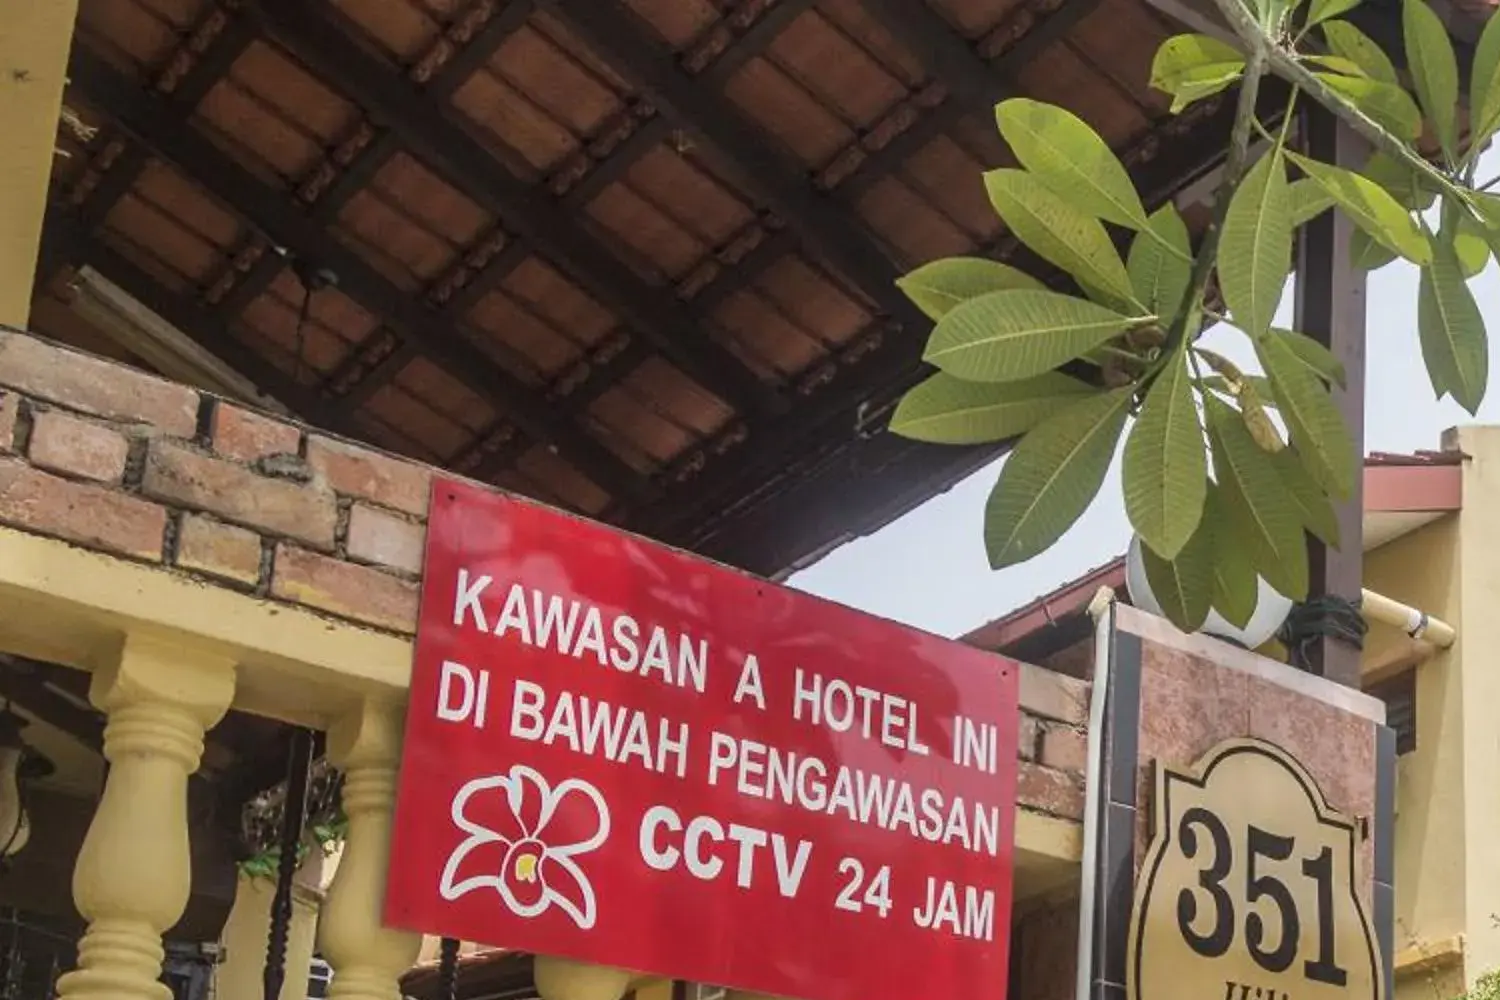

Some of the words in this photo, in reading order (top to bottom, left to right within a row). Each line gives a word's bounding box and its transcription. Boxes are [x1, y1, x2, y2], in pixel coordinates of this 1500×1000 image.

[436, 660, 490, 728] DI
[509, 678, 690, 777] BAWAH
[708, 730, 1000, 857] PENGAWASAN
[453, 568, 708, 693] KAWASAN
[733, 653, 767, 710] A
[793, 667, 930, 757] HOTEL
[953, 713, 999, 775] INI
[638, 805, 814, 899] CCTV
[833, 857, 894, 919] 24
[912, 875, 997, 942] JAM
[1177, 807, 1349, 987] 351
